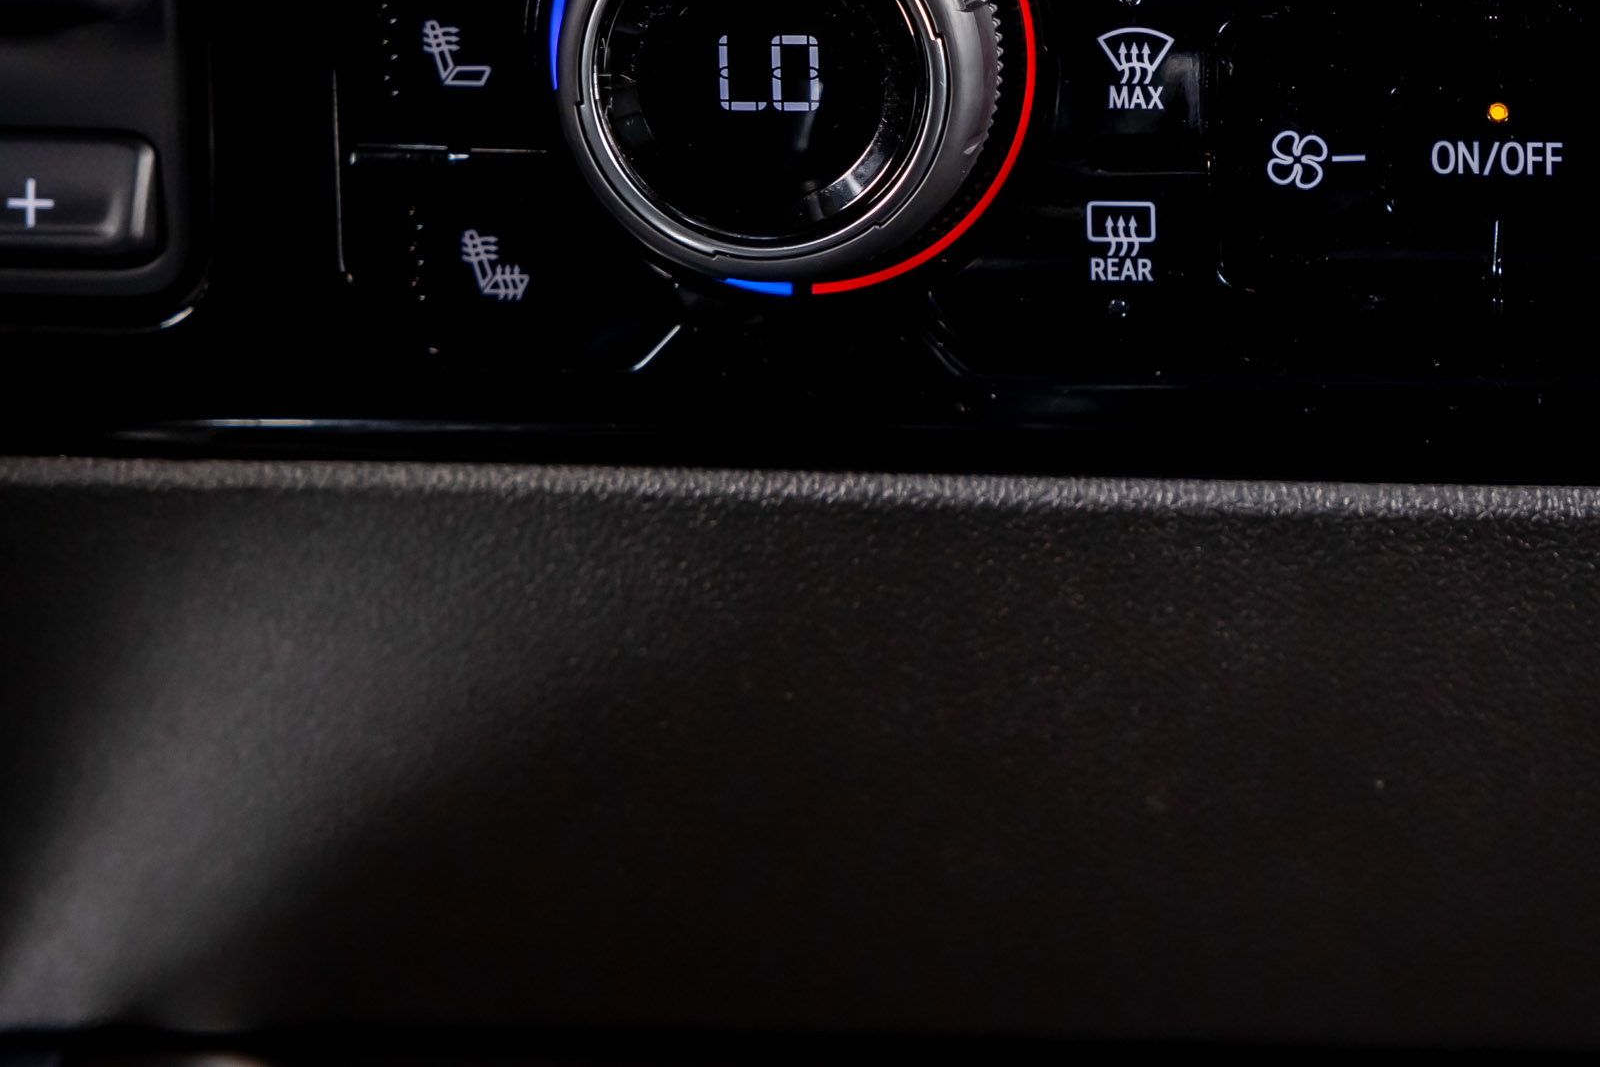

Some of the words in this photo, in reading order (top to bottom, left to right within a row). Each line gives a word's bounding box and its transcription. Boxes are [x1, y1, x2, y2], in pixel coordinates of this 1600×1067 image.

[718, 34, 820, 112] LO
[1108, 86, 1165, 110] MAX
[1431, 140, 1563, 176] ON/OFF
[1090, 257, 1154, 282] REAR
